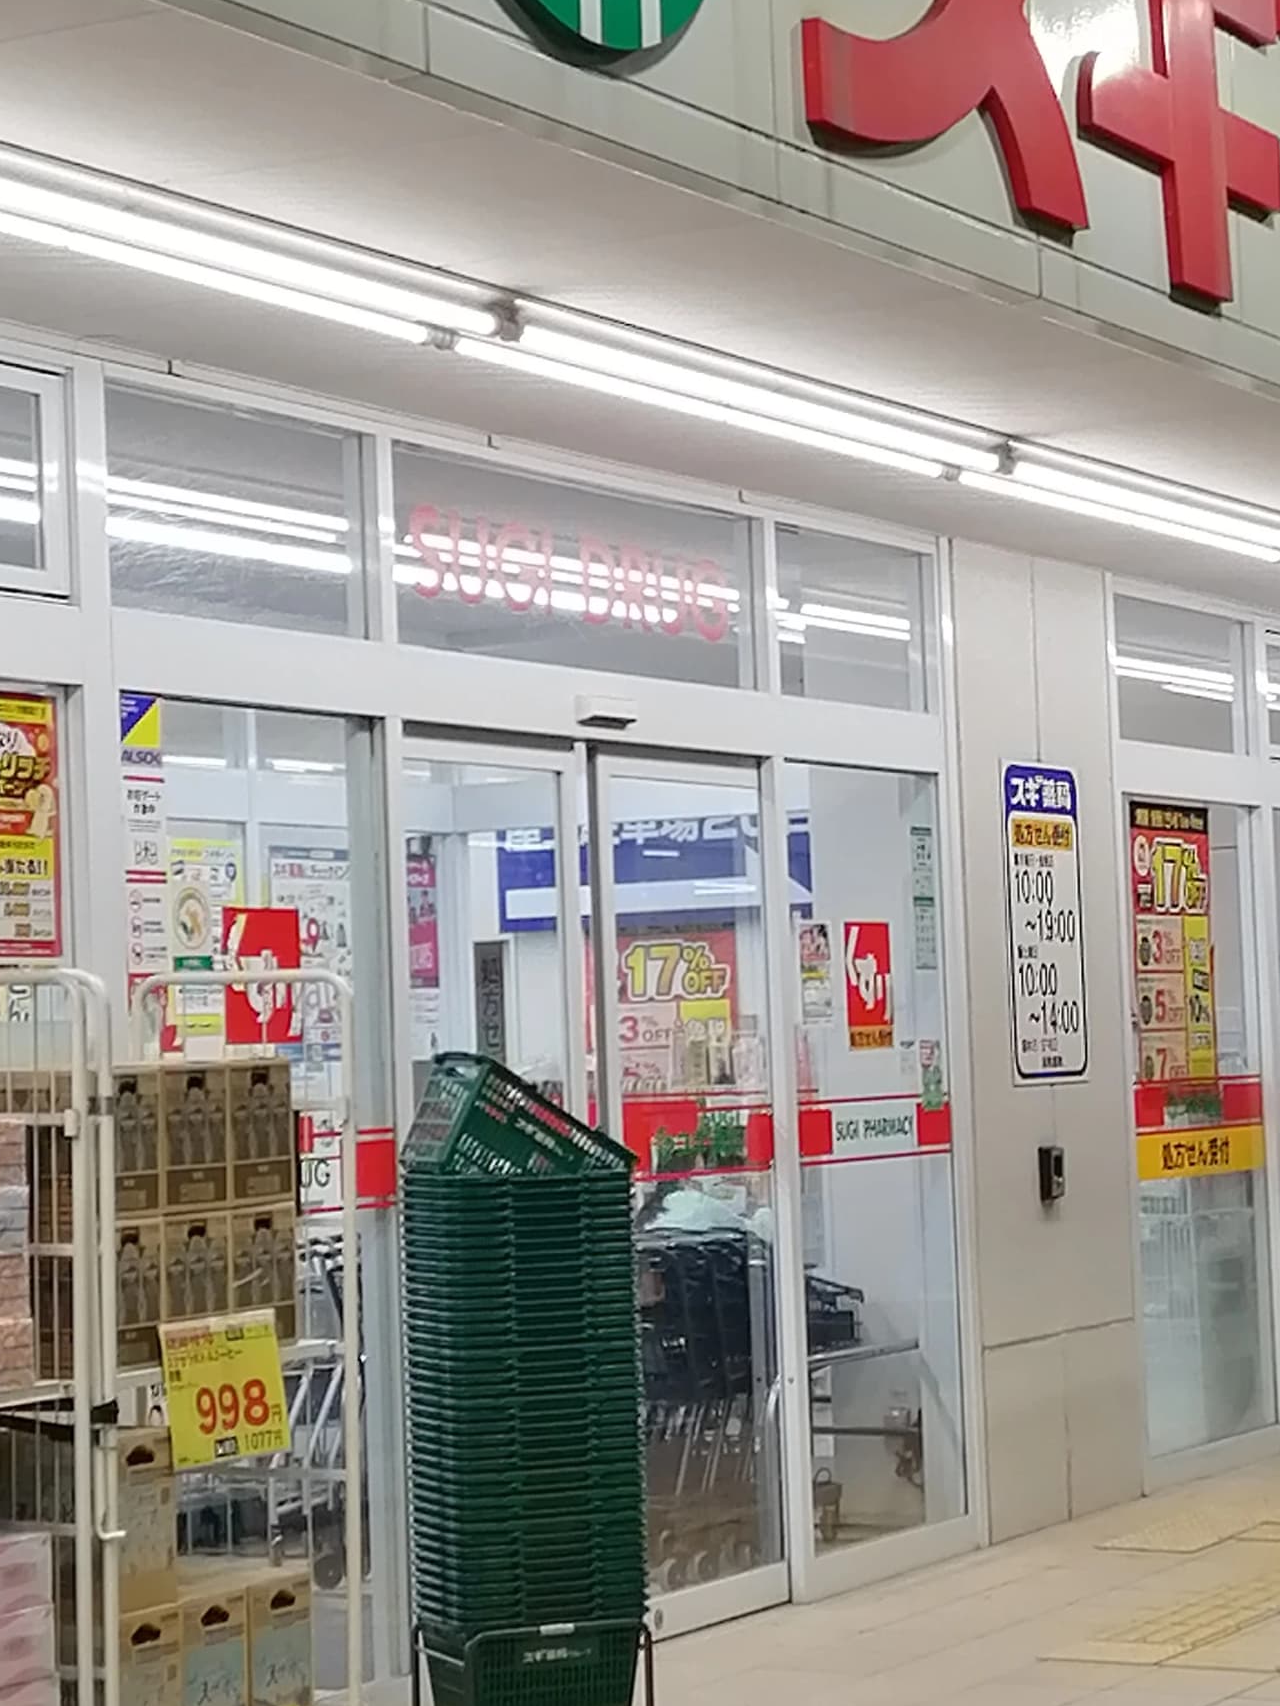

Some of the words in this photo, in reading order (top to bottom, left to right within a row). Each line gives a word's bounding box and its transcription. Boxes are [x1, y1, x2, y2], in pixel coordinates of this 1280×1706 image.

[410, 505, 552, 617] SUGI
[579, 535, 728, 642] DRUG
[1010, 775, 1072, 810] スギ薬局
[1015, 869, 1054, 907] 10:00
[1019, 963, 1058, 997] 10:00
[836, 1119, 860, 1142] SUGI
[1161, 1136, 1230, 1170] 処方せん受付
